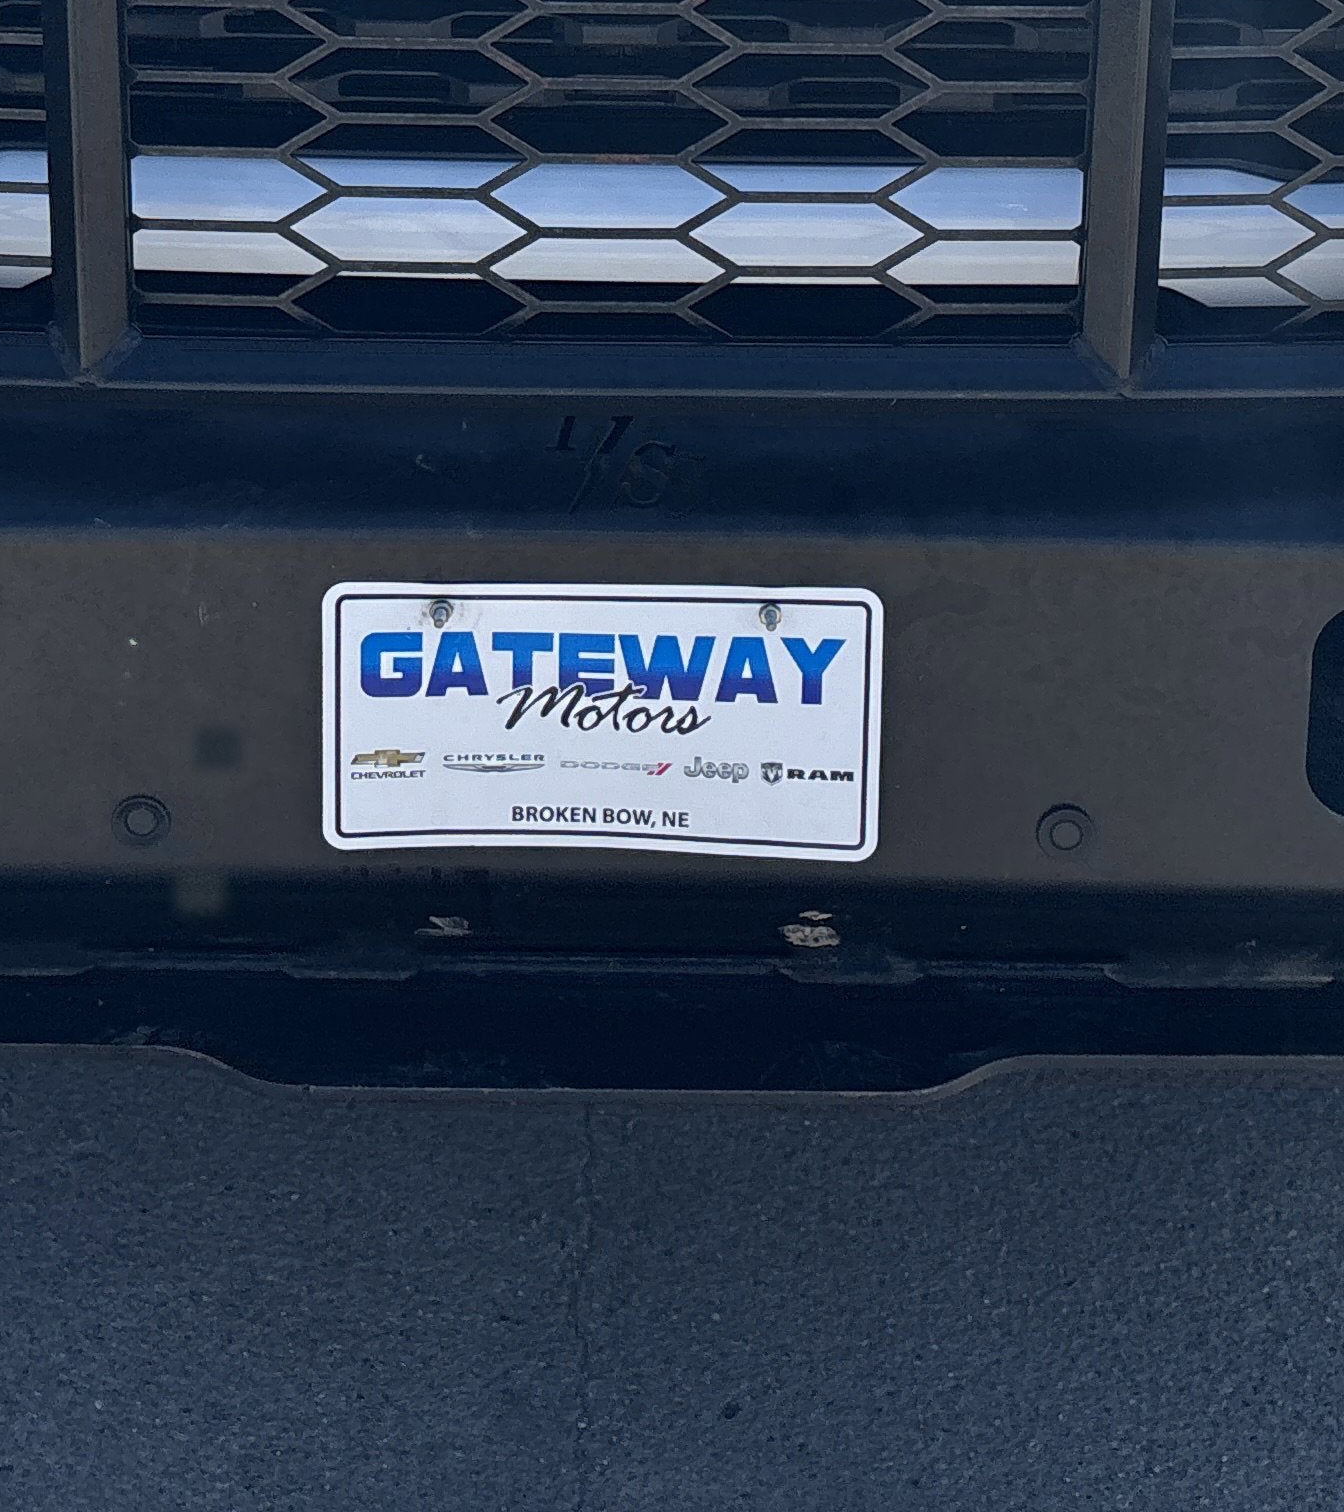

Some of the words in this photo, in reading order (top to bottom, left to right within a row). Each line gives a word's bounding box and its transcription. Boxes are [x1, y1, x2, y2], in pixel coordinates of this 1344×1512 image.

[359, 630, 847, 705] GATEWAY
[496, 681, 712, 735] Motors
[443, 753, 545, 762] CHRYSLER
[559, 759, 659, 772] DODGE
[350, 769, 426, 780] CHEVROLET
[683, 756, 749, 783] Jeep
[786, 768, 855, 782] RAM
[511, 805, 596, 824] BROKEN
[602, 808, 657, 829] BOW,
[662, 810, 690, 829] NE
